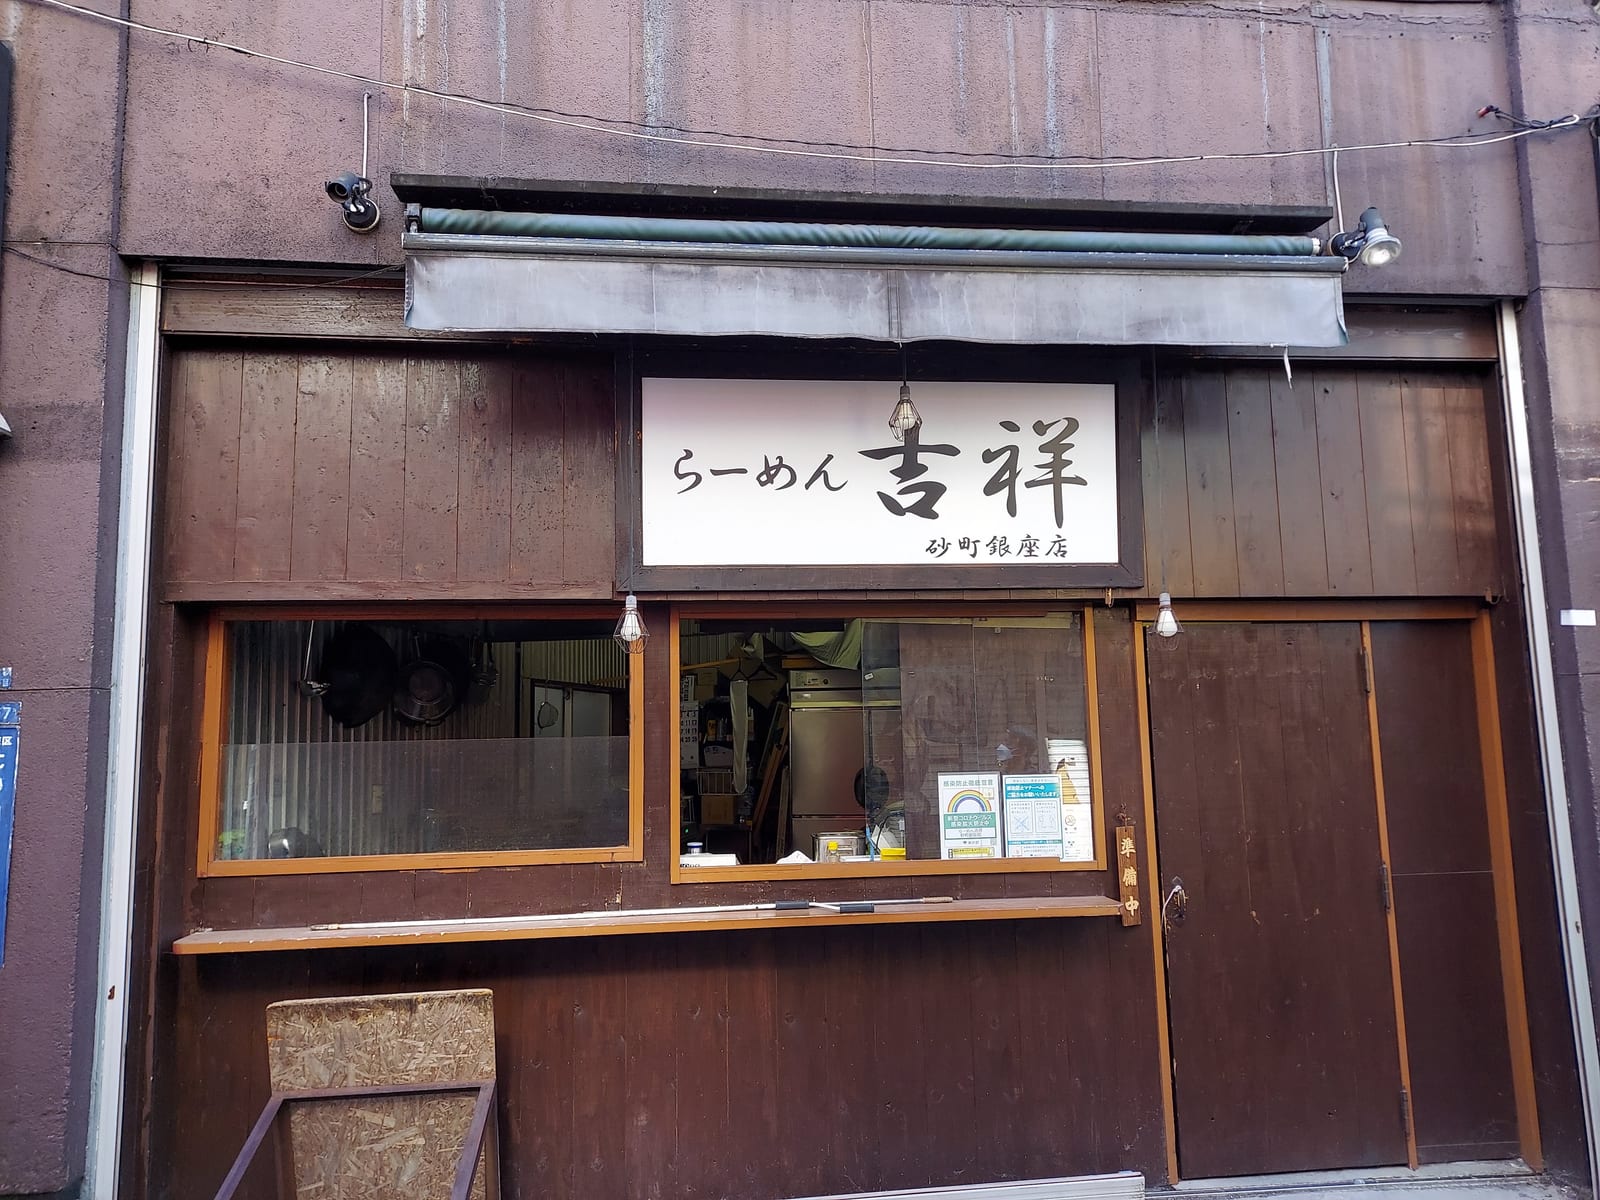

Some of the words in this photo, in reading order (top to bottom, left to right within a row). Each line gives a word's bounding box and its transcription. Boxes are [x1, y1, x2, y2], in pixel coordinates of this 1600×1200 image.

[673, 448, 848, 494] らーめん
[857, 416, 1088, 529] 吉祥
[925, 534, 1069, 561] 砂町銀座店
[1119, 837, 1140, 918] 準備中
